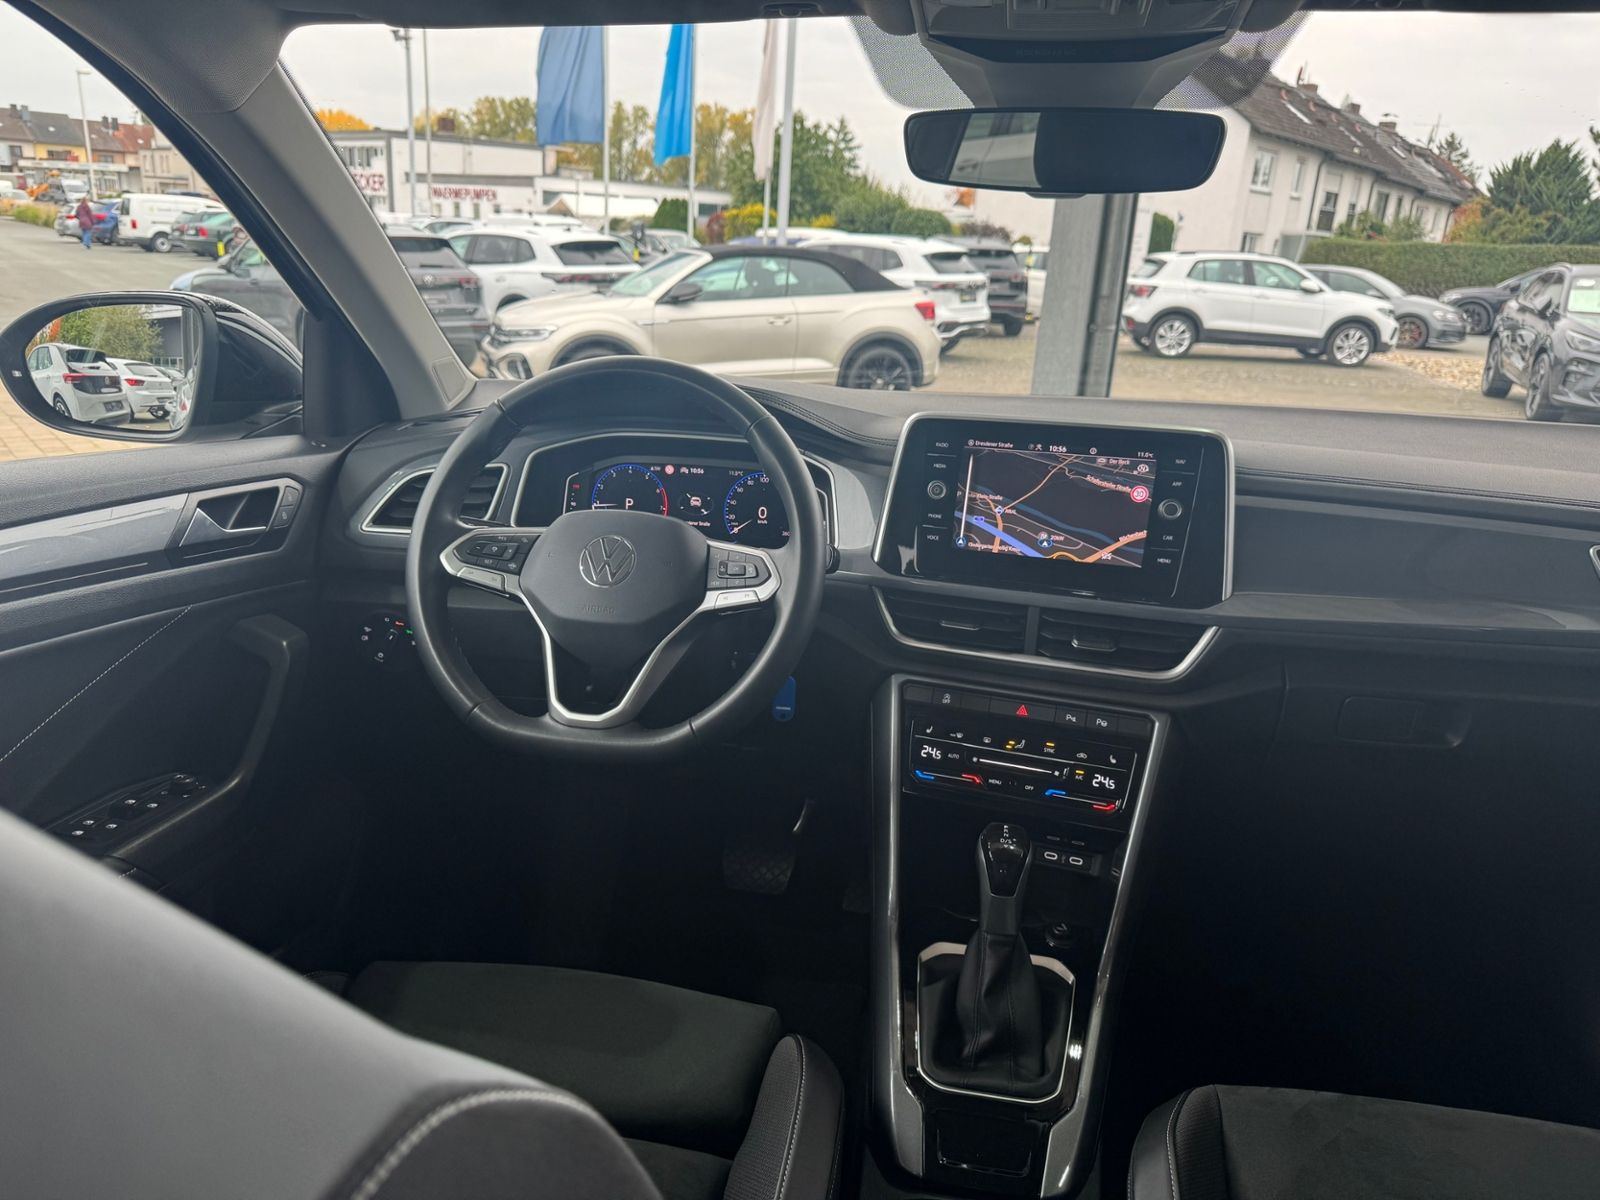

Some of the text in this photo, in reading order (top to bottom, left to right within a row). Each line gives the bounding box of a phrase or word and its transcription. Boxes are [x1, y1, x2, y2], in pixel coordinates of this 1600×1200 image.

[1049, 445, 1067, 453] 10:56
[1135, 490, 1145, 498] 30
[625, 497, 634, 510] P
[757, 506, 768, 519] 0
[1157, 556, 1171, 564] MENU
[948, 752, 960, 760] AUTO
[1025, 783, 1035, 791] OFF
